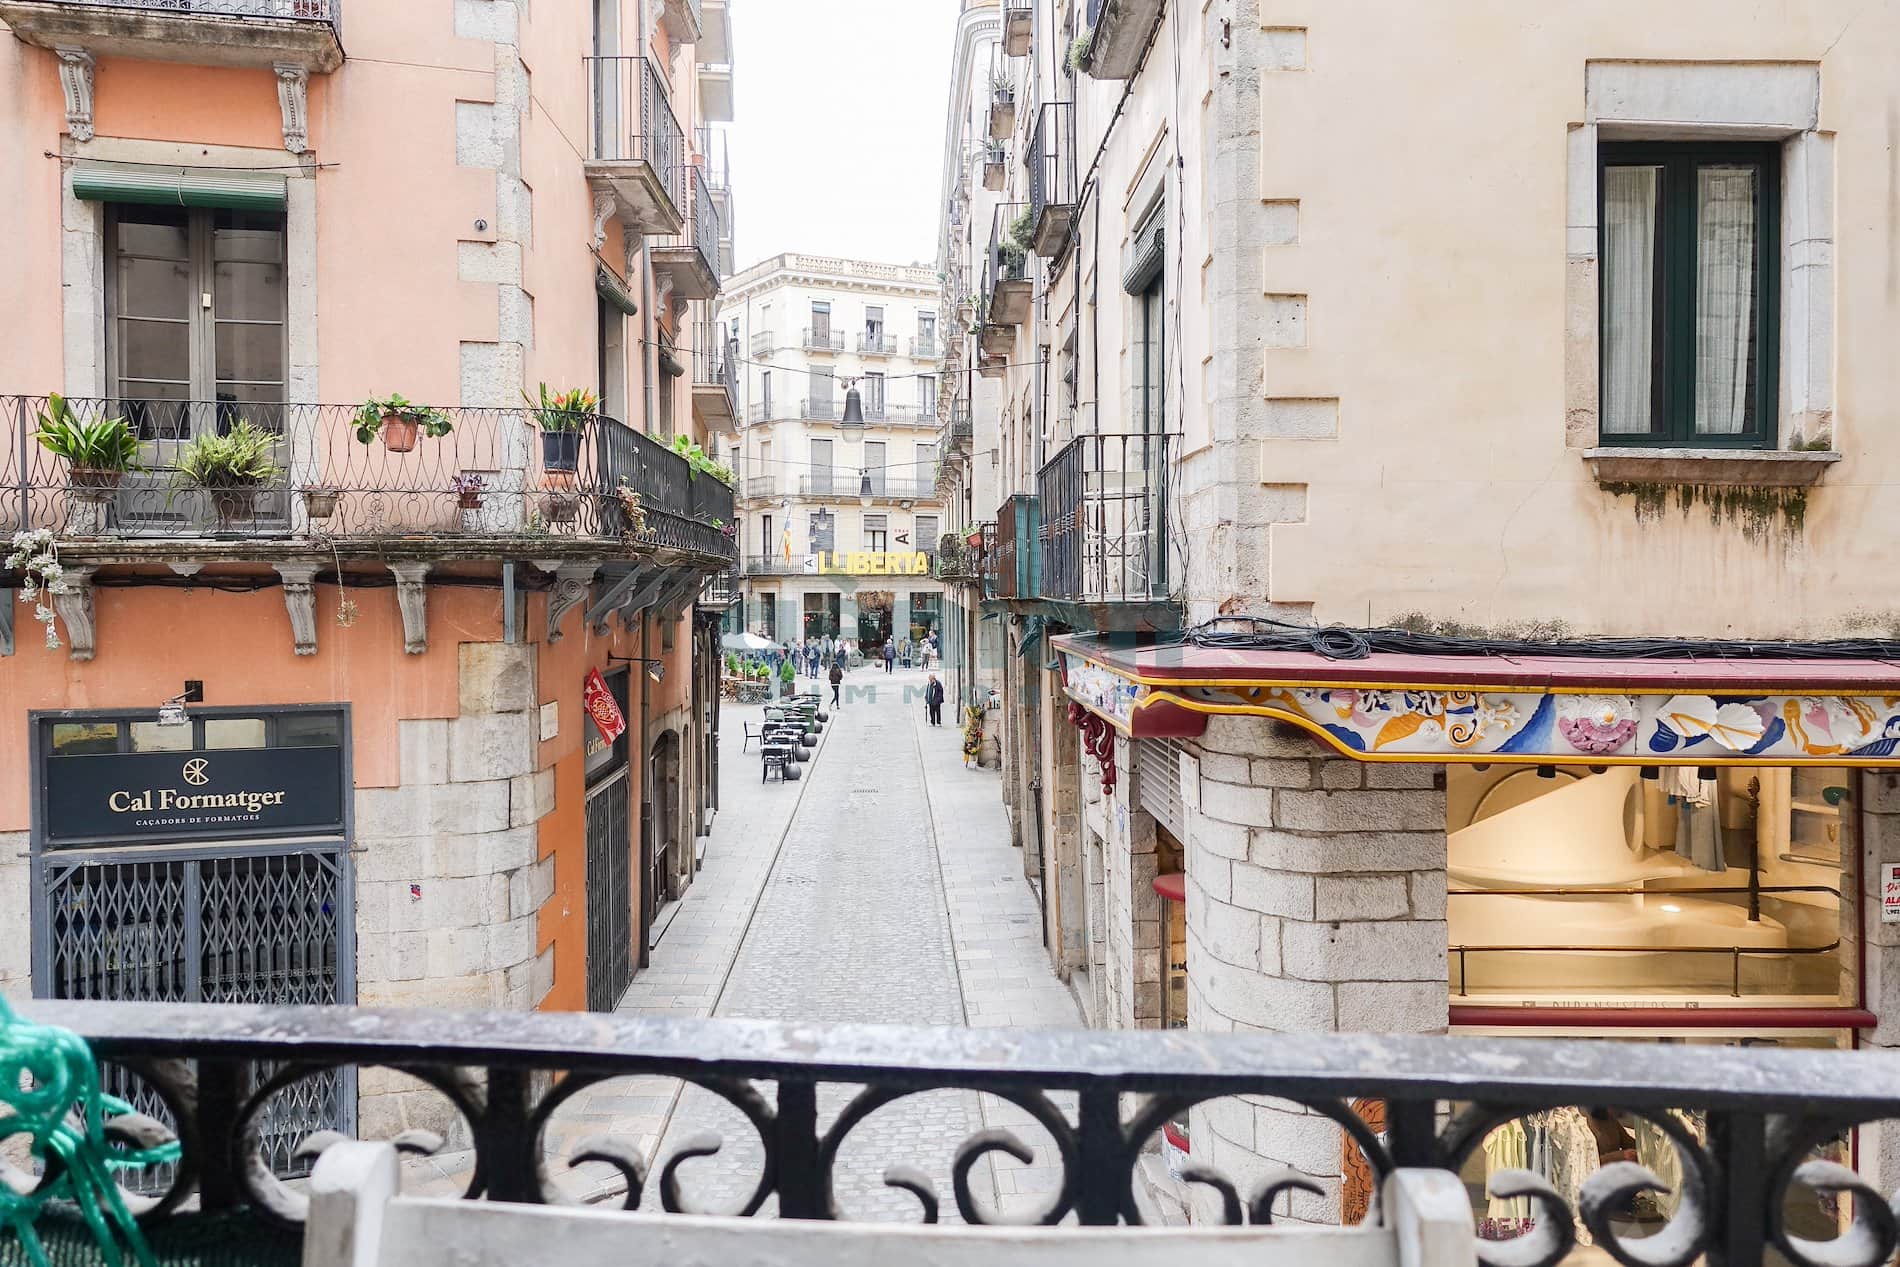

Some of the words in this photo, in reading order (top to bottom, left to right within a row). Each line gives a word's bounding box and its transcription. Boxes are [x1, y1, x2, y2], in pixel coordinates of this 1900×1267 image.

[108, 790, 153, 812] Cal
[158, 789, 286, 812] Formatger
[135, 817, 186, 826] CAÇADORS
[205, 814, 260, 823] FORMATGES
